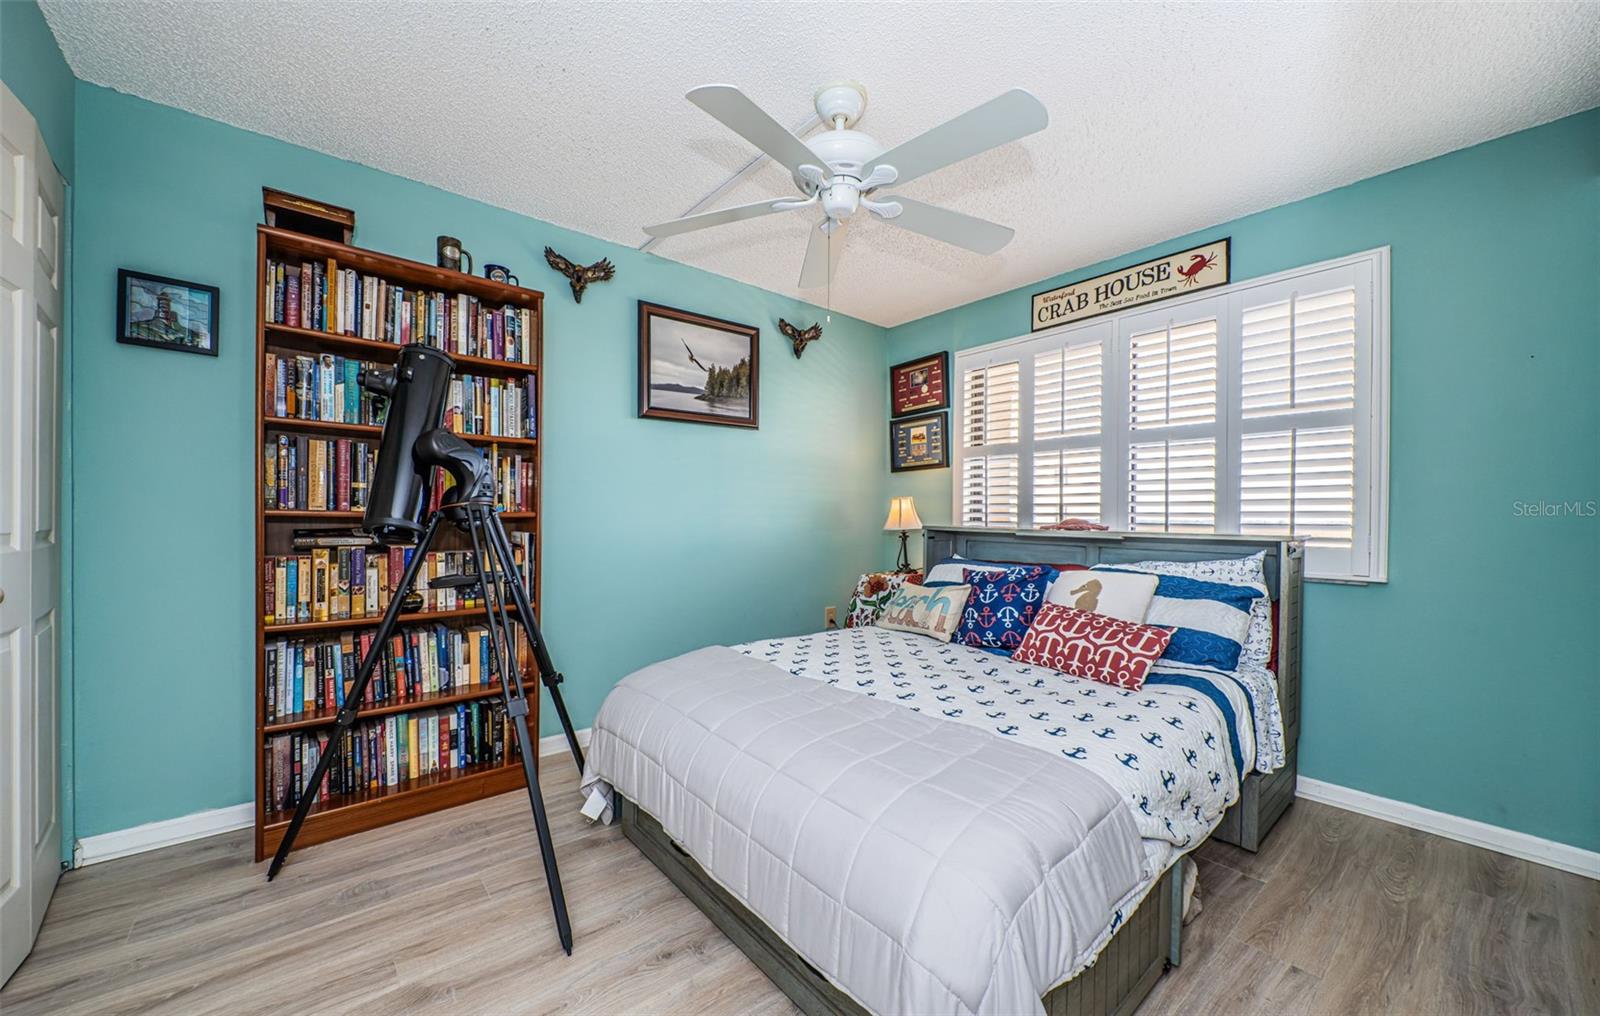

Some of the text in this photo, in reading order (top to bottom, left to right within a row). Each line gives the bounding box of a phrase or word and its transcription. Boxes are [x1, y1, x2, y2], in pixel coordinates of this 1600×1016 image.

[1037, 261, 1172, 323] CRAB HOUSE
[1042, 288, 1076, 304] Waterford
